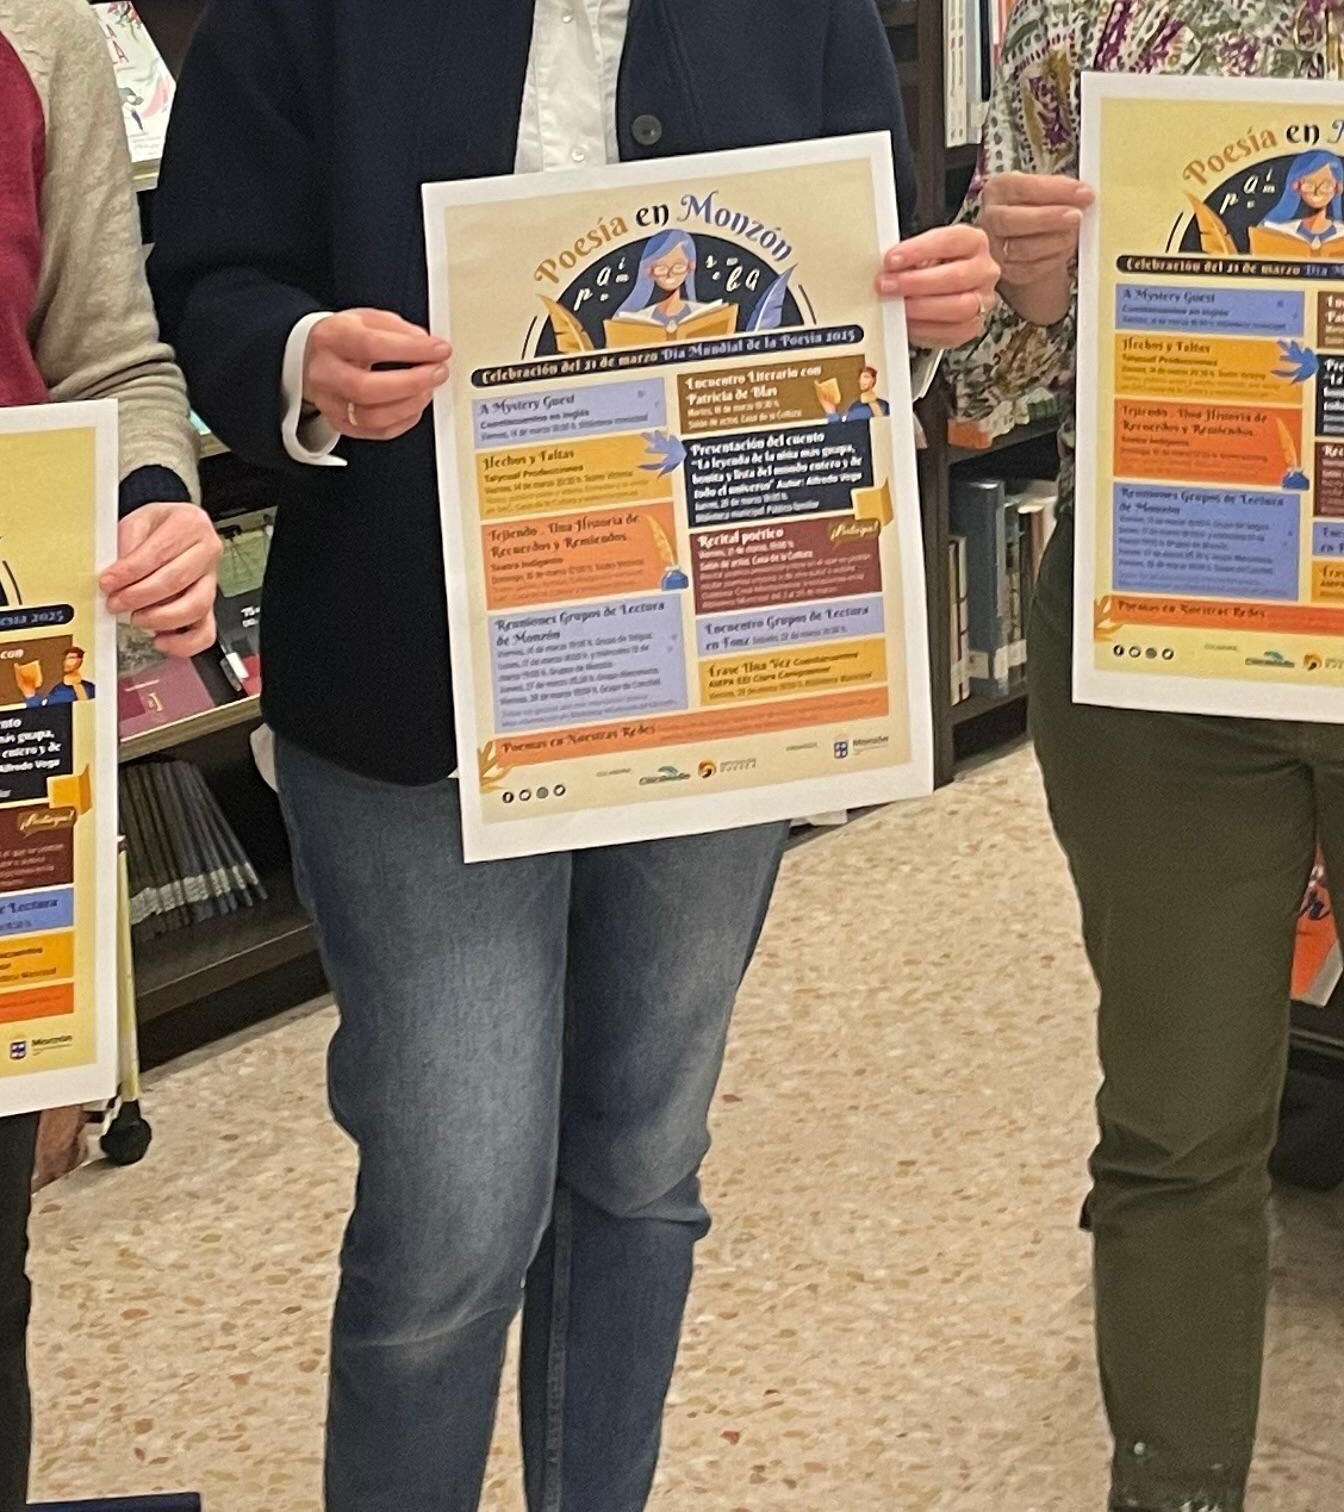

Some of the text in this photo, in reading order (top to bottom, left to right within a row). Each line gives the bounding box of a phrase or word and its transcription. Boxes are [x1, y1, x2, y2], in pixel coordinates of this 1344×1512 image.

[1183, 126, 1277, 186] Poesía
[1287, 122, 1320, 146] en
[535, 191, 795, 284] Poesía en Monzón
[482, 362, 558, 384] Celebración
[560, 359, 580, 374] del
[598, 355, 615, 369] de
[618, 351, 658, 367] marzo
[745, 338, 763, 352] de
[763, 336, 777, 350] la
[685, 365, 821, 390] Encuentro Literario con
[479, 392, 575, 415] A Mystery Guest
[686, 383, 777, 406] Patricia de Blas
[690, 430, 824, 457] Presentación del cuento
[529, 454, 535, 465] y
[697, 525, 784, 549] Recital poético
[0, 648, 24, 660] con
